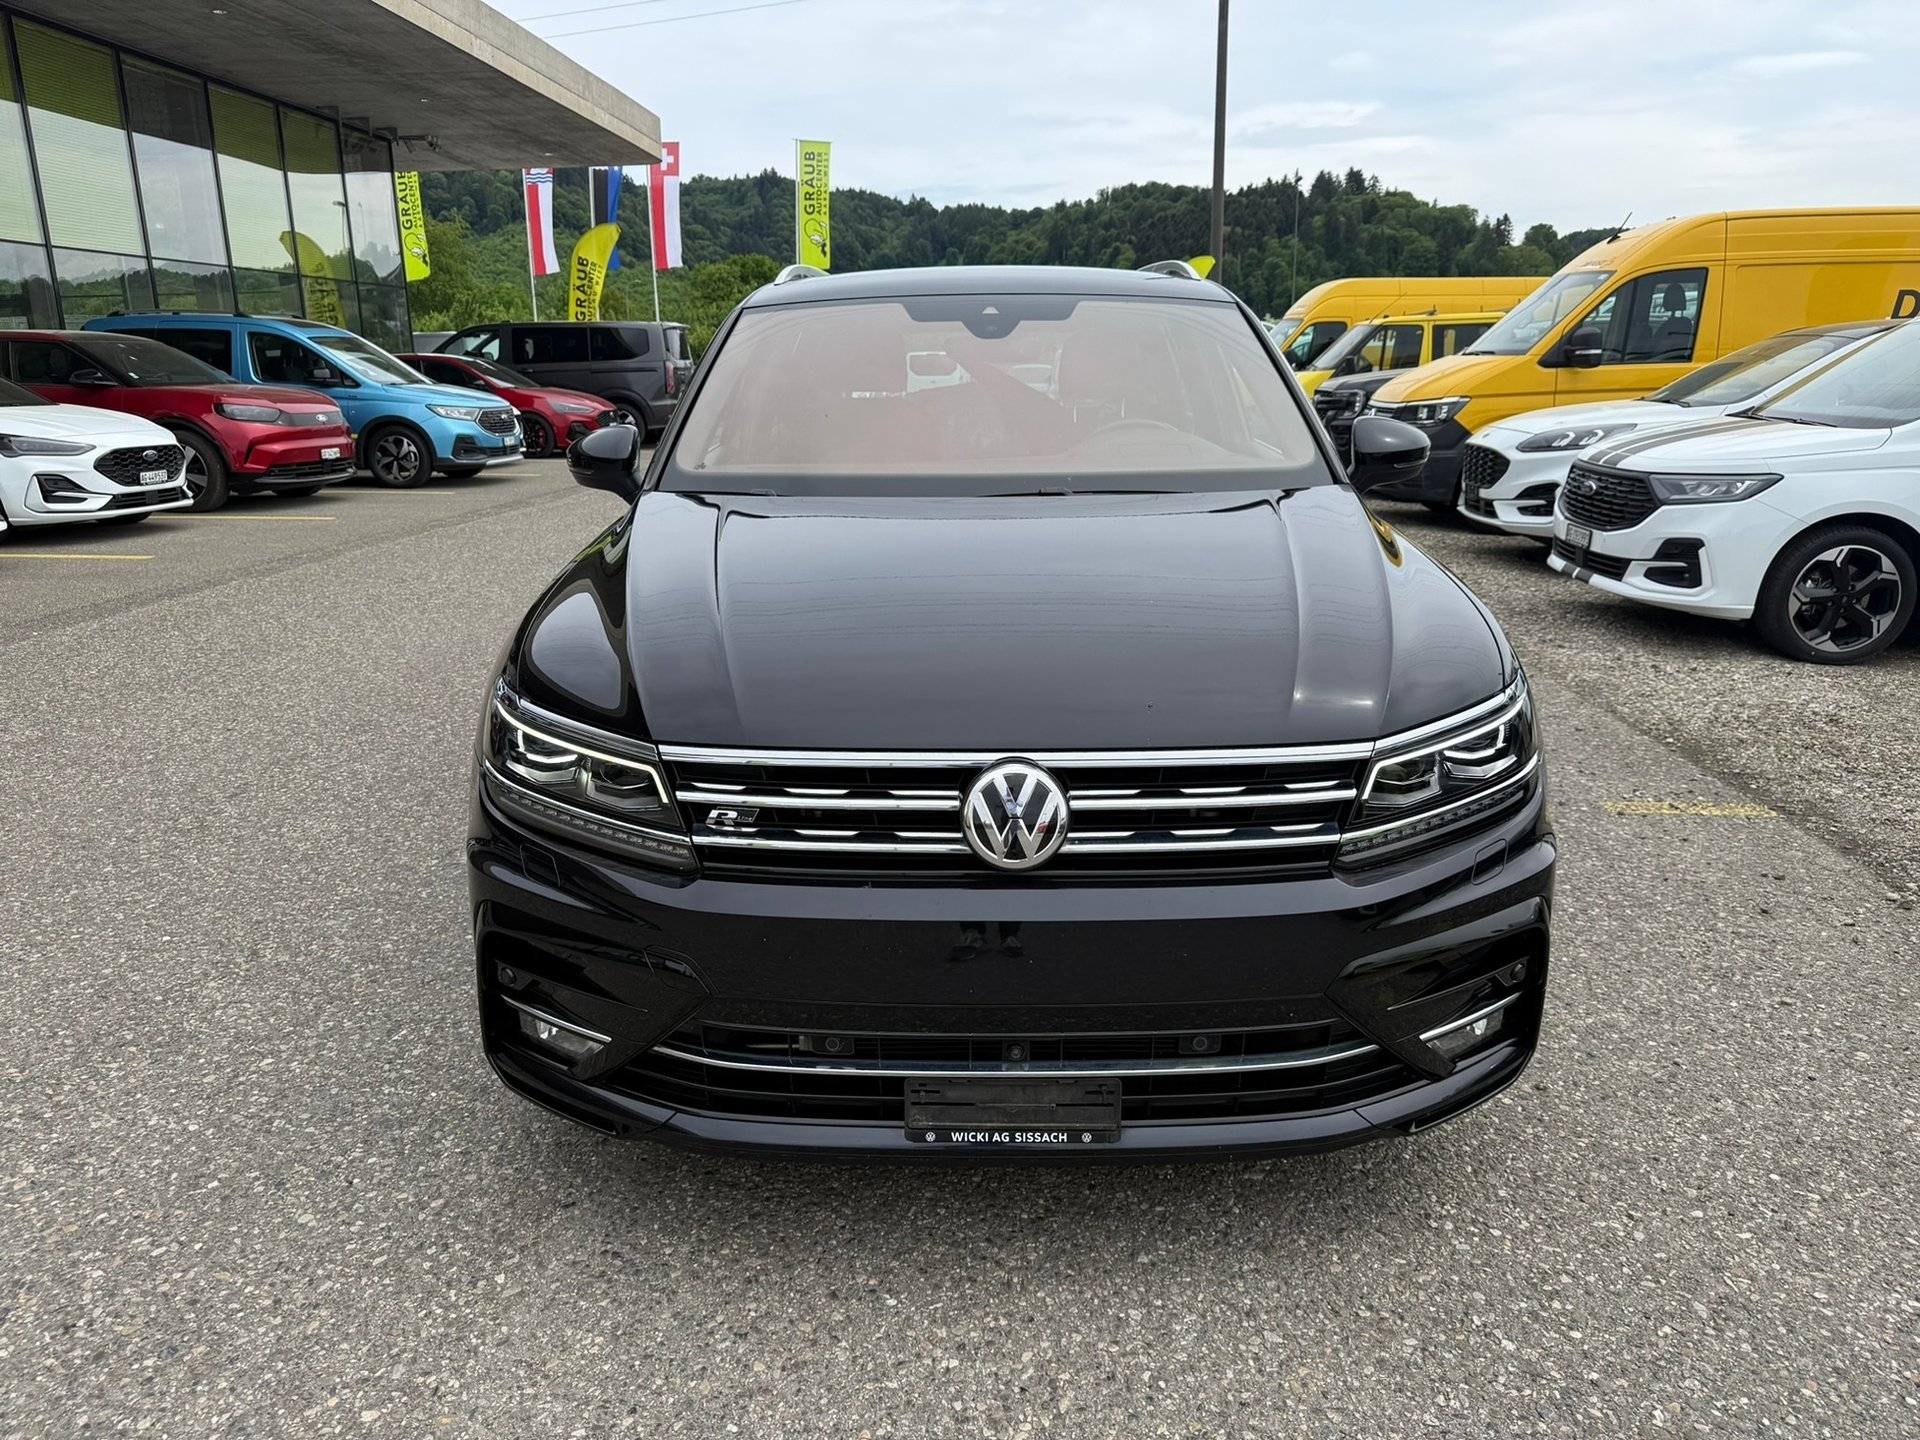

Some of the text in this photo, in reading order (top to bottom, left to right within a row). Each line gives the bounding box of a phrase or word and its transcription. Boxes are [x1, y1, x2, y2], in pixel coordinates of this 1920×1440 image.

[801, 151, 815, 215] GRÄUB
[572, 255, 589, 321] GRÄUB
[1890, 289, 1920, 319] D
[951, 1132, 1068, 1143] WICKI AG SISSACH
